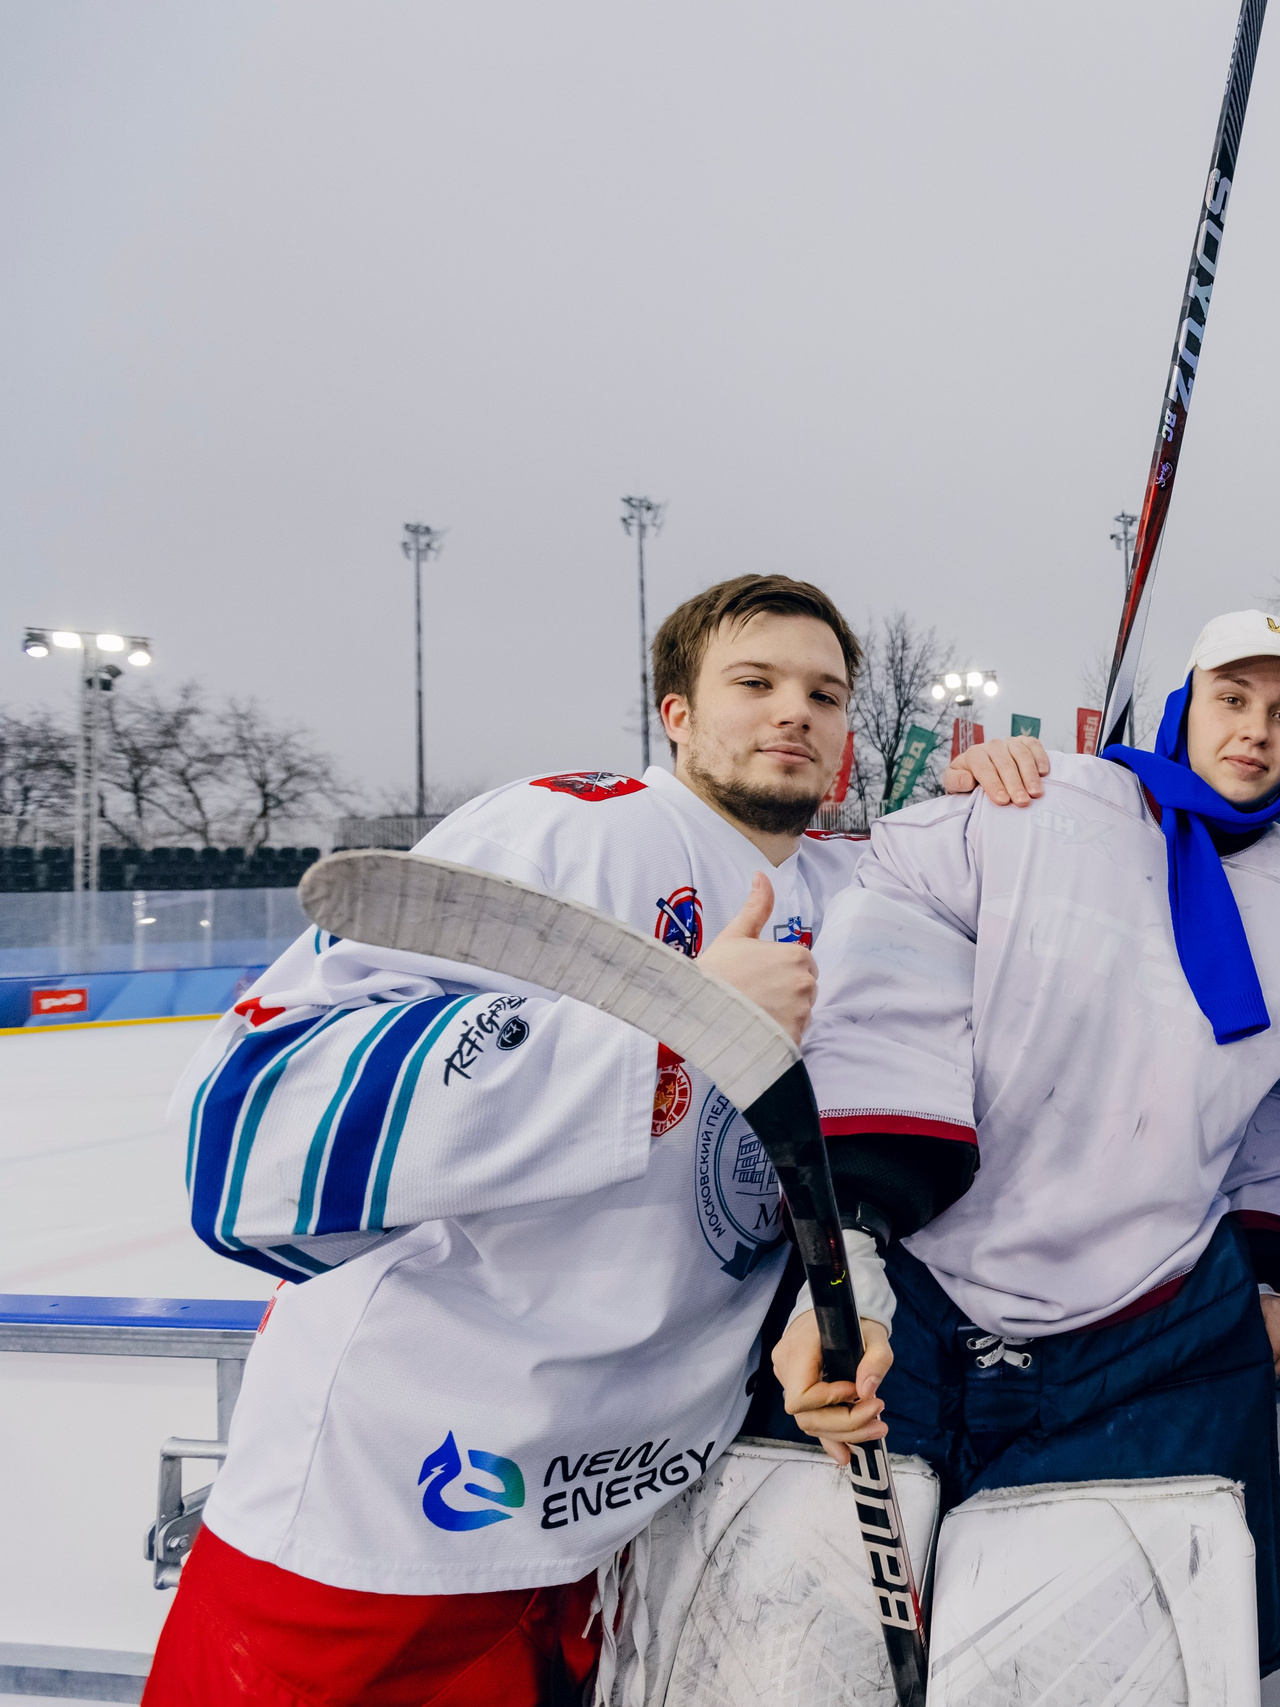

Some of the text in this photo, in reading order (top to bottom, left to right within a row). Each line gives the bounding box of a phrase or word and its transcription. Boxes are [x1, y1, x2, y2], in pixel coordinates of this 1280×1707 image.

[1168, 167, 1232, 413] SOYUZ
[699, 1132, 727, 1239] МОСКОВСКИЙ
[540, 1440, 716, 1530] ENERGY
[543, 1438, 671, 1488] NEW
